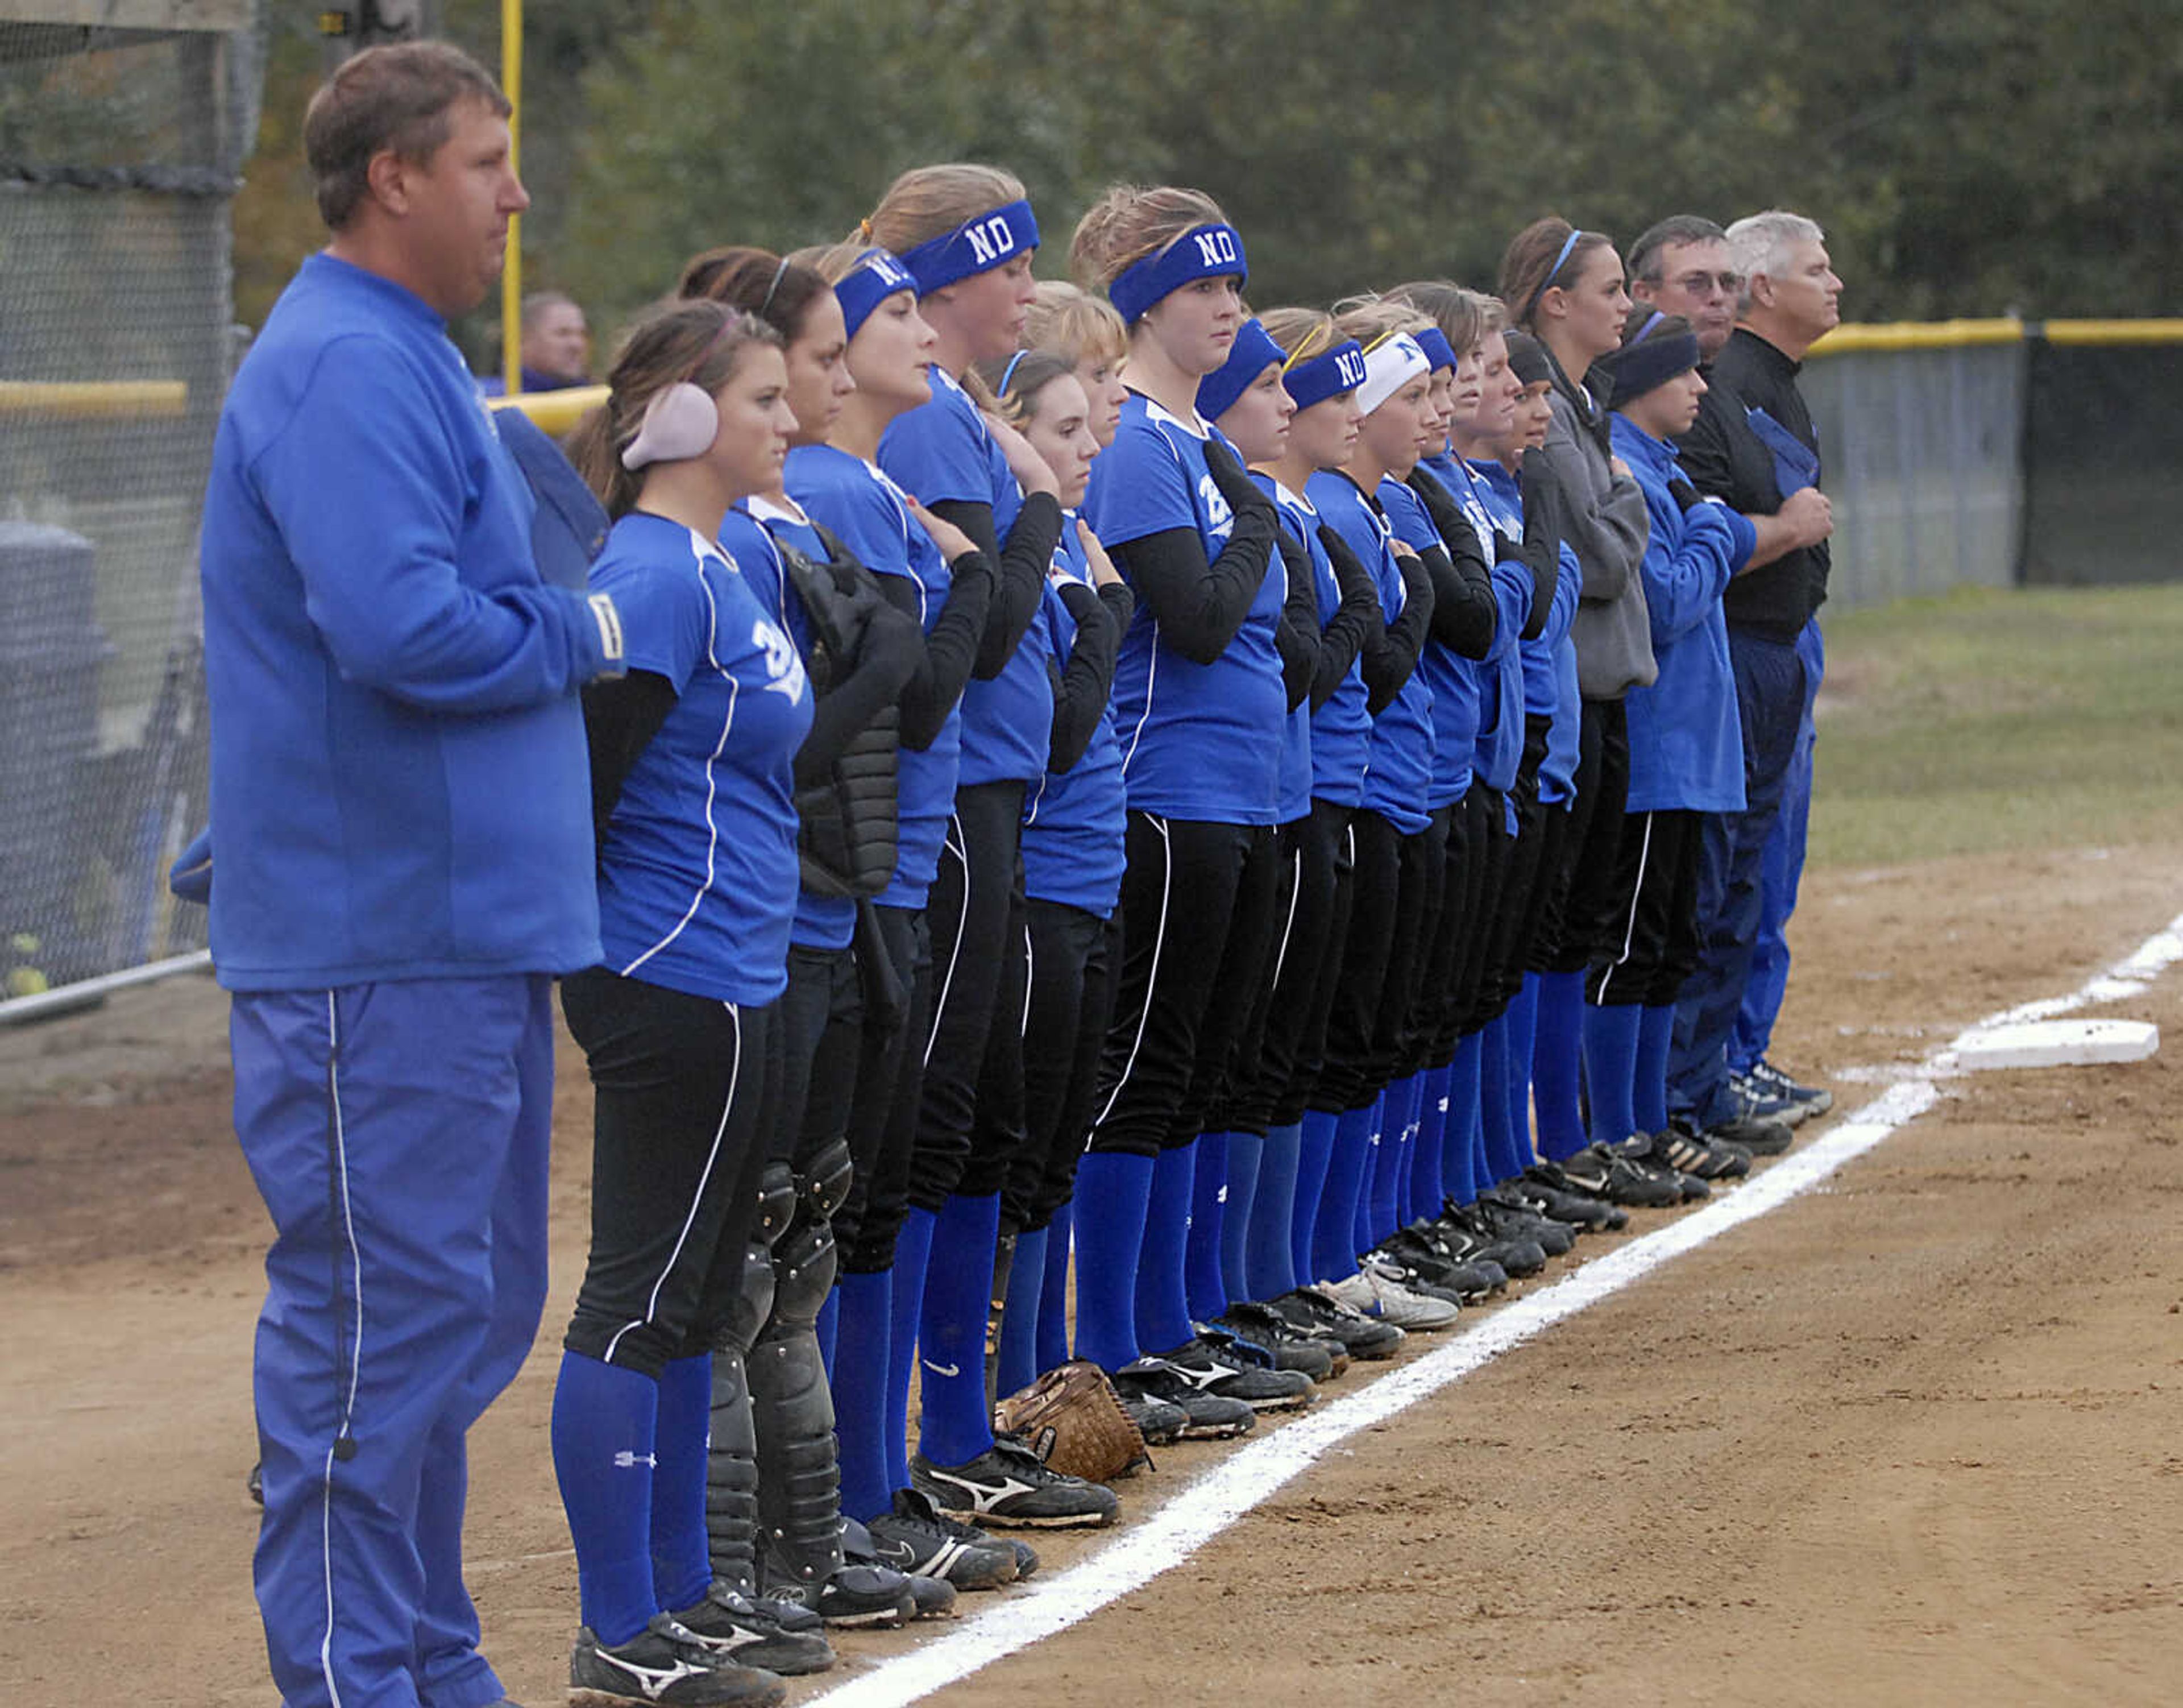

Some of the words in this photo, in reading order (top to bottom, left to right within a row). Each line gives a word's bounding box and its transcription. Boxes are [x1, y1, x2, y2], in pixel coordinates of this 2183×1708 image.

[965, 216, 1014, 265] ND
[1194, 231, 1236, 267] ND
[1335, 350, 1364, 387] ND
